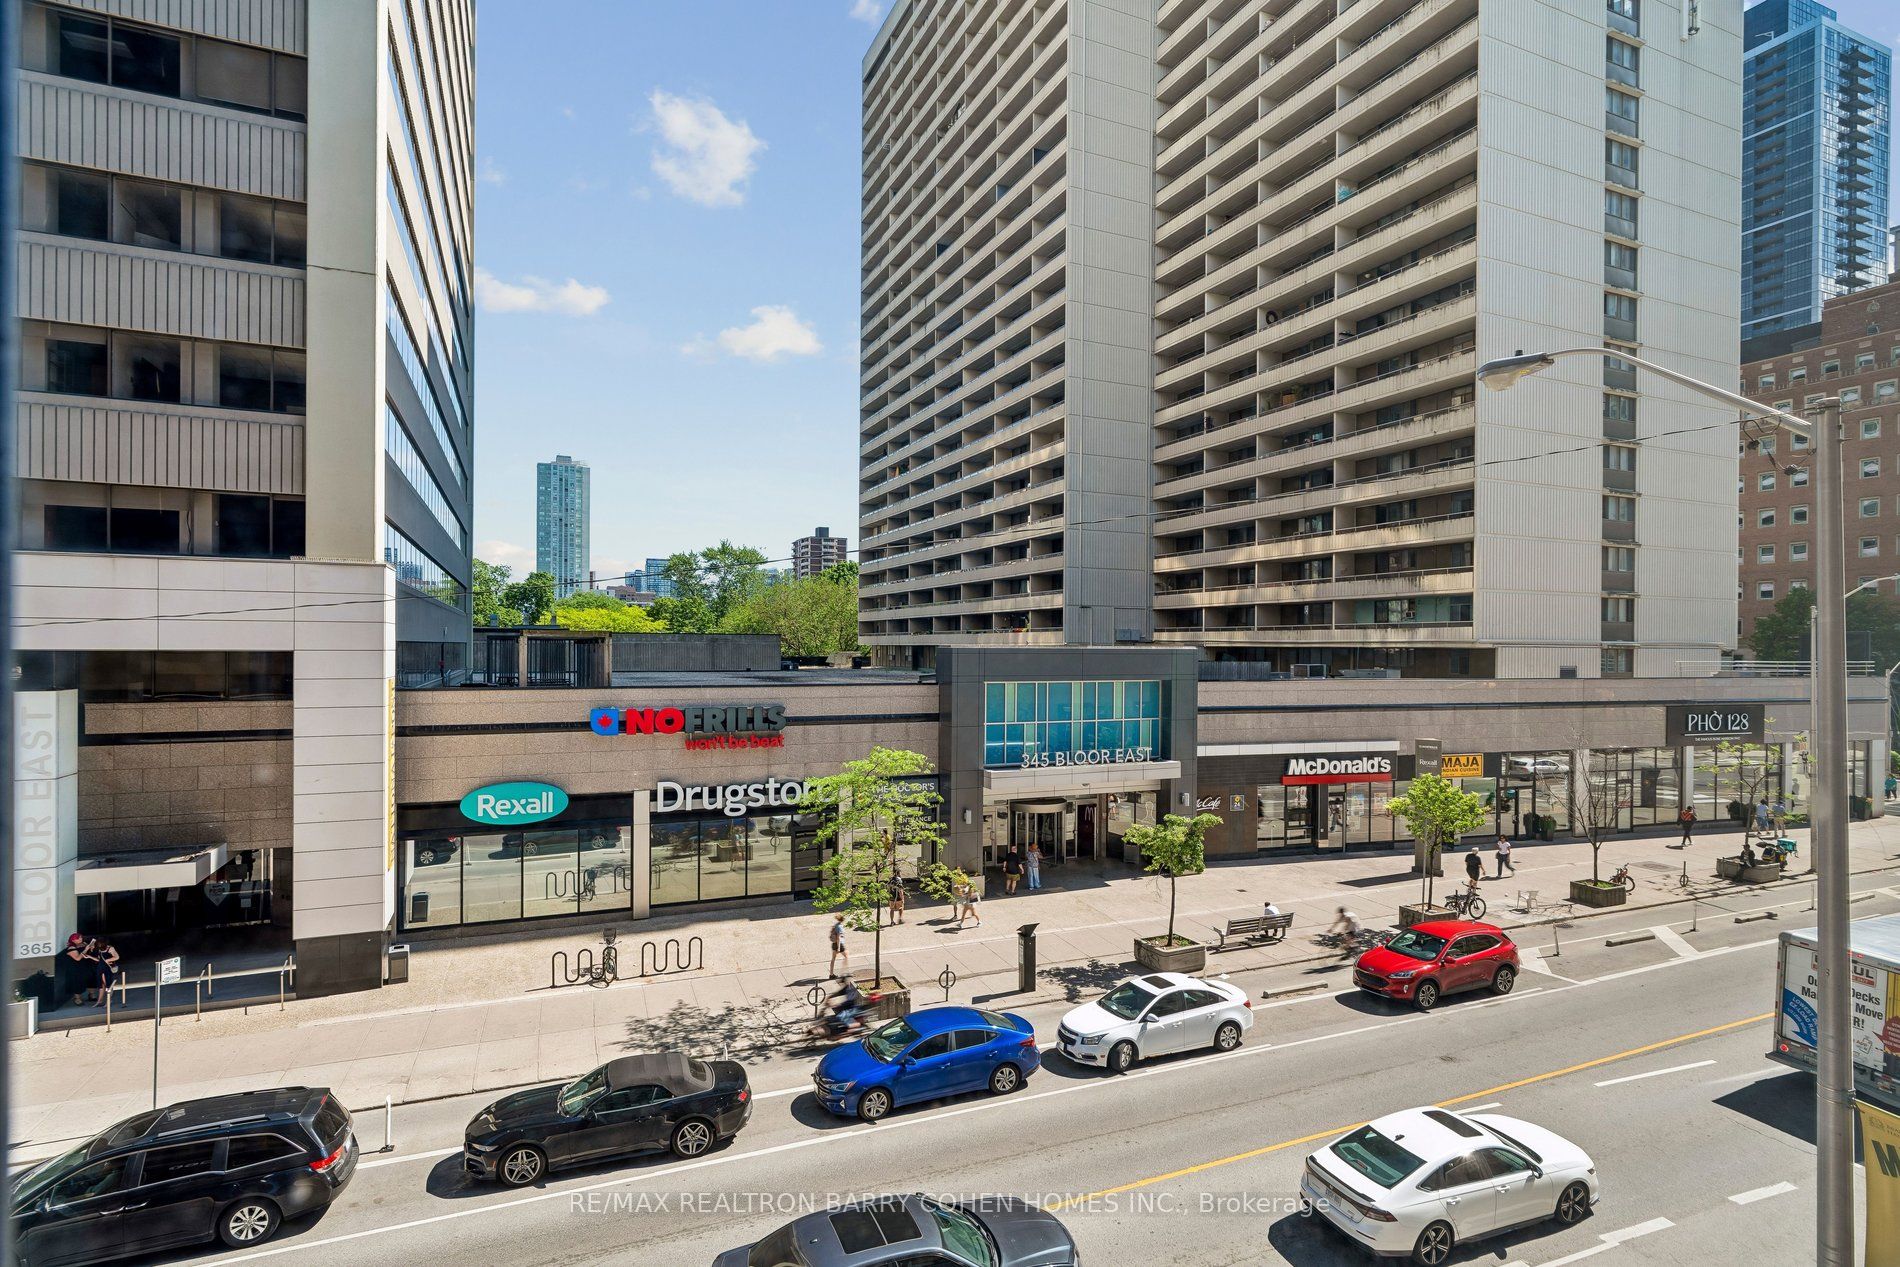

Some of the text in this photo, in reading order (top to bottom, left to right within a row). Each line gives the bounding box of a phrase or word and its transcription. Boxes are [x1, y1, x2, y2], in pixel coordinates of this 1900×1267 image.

[1727, 713, 1749, 730] 128
[685, 734, 785, 750] won't be beat
[1021, 747, 1153, 768] 345 BLOOR EAST
[1287, 757, 1391, 775] McDonald's
[1442, 757, 1479, 768] MAJA
[477, 791, 554, 819] Rexall
[20, 706, 53, 943] BLOOR EAST
[20, 942, 52, 956] 365
[1855, 1002, 1884, 1021] Move
